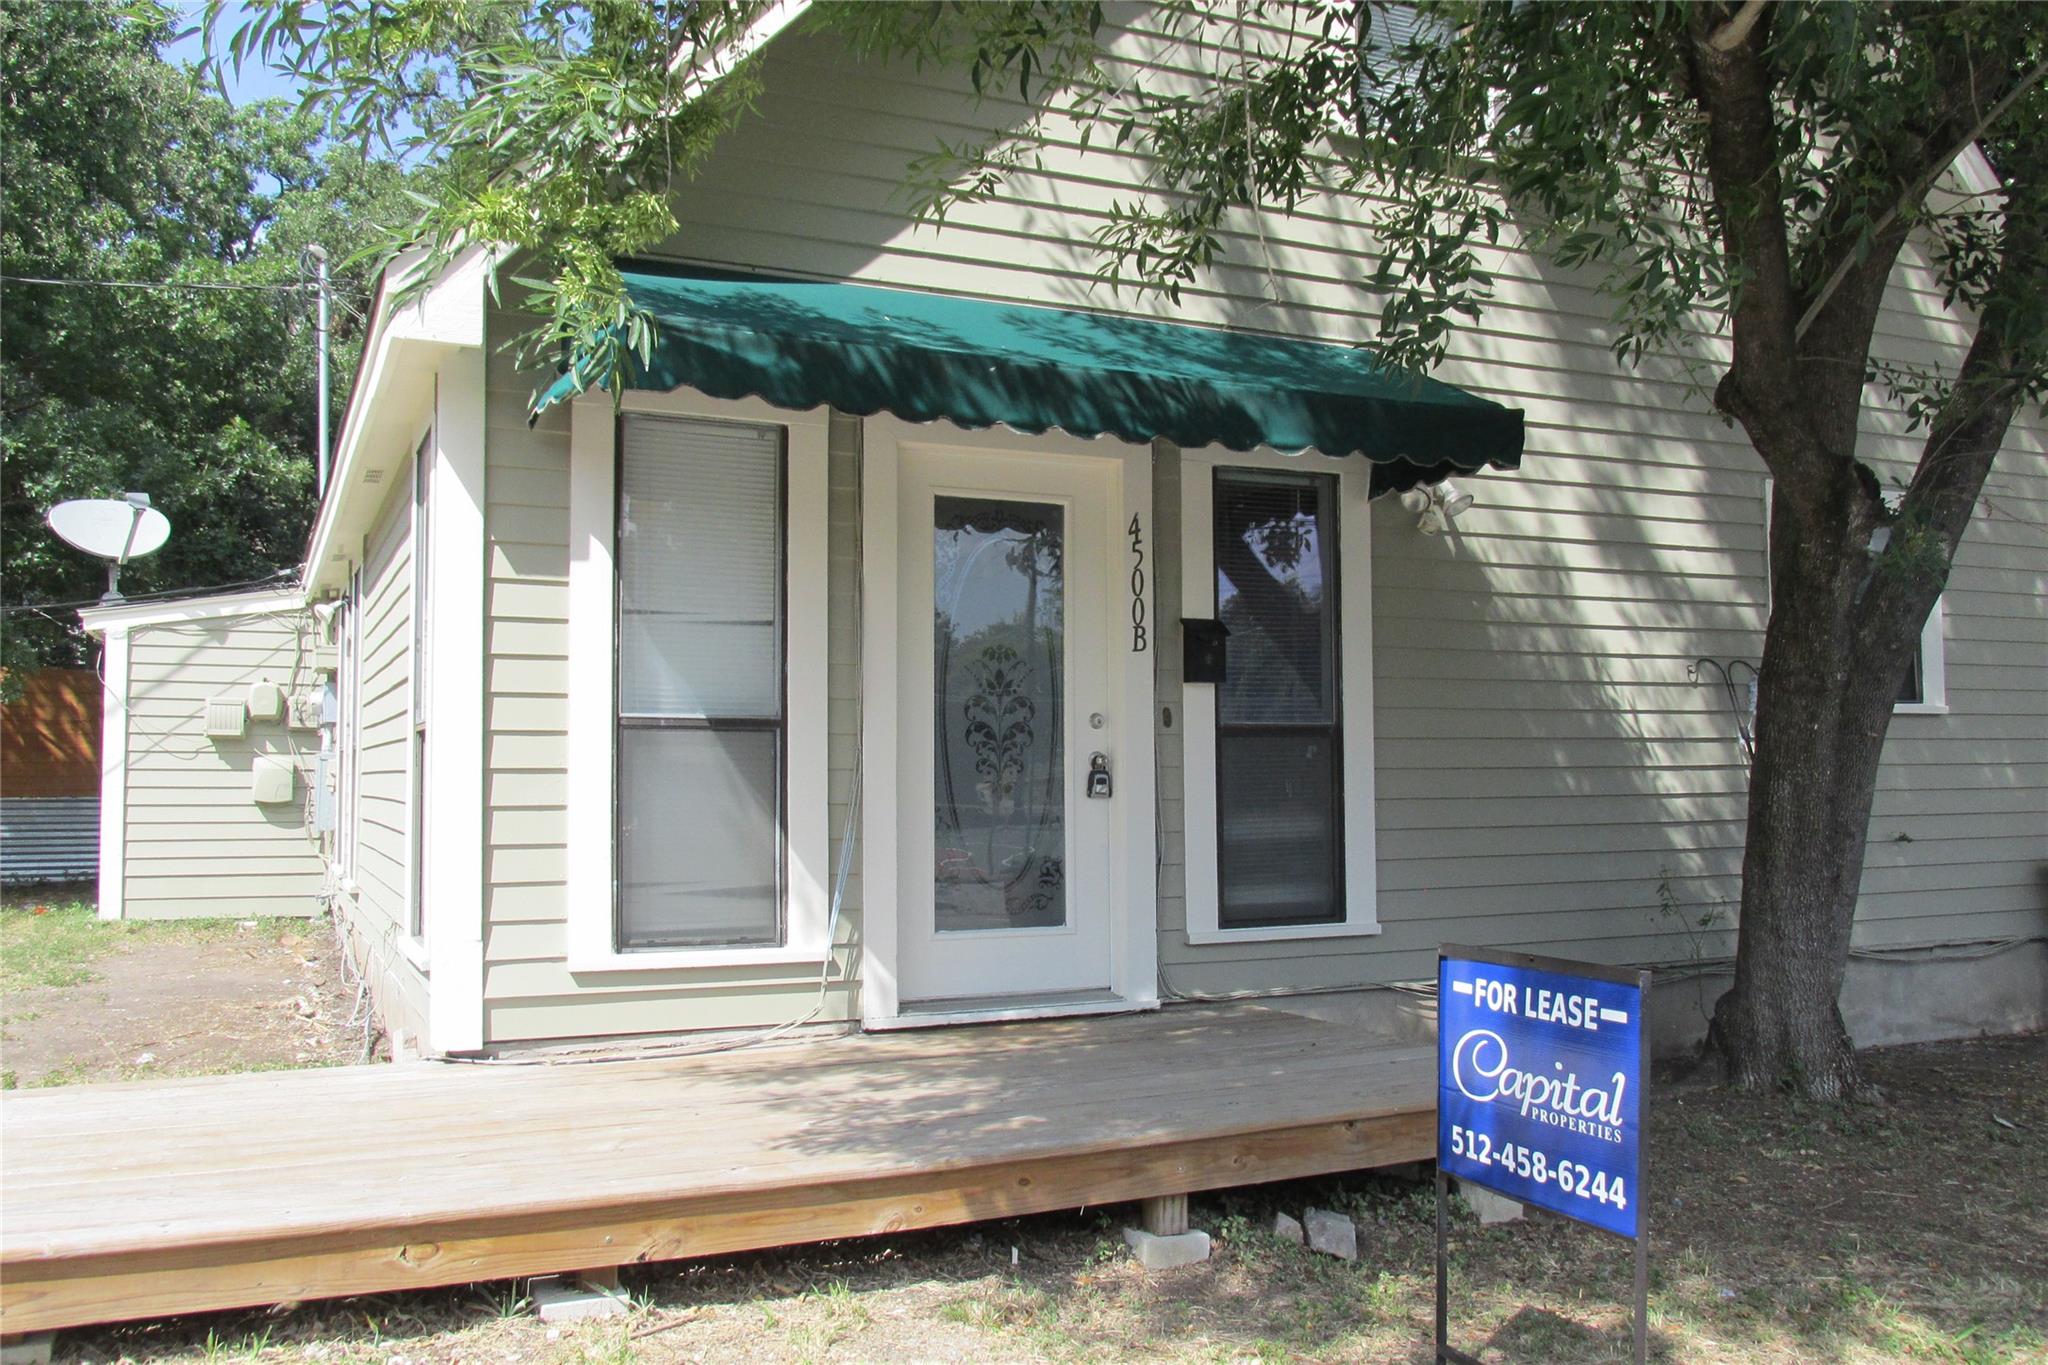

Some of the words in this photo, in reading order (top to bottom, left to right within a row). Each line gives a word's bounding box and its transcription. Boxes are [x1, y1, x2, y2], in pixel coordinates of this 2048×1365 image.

[1474, 978, 1517, 1014] FOR
[1525, 987, 1598, 1029] LEASE
[1453, 1029, 1626, 1126] Capital
[1532, 1107, 1622, 1143] PROPERTIES
[1451, 1125, 1626, 1210] 512-458-6244
